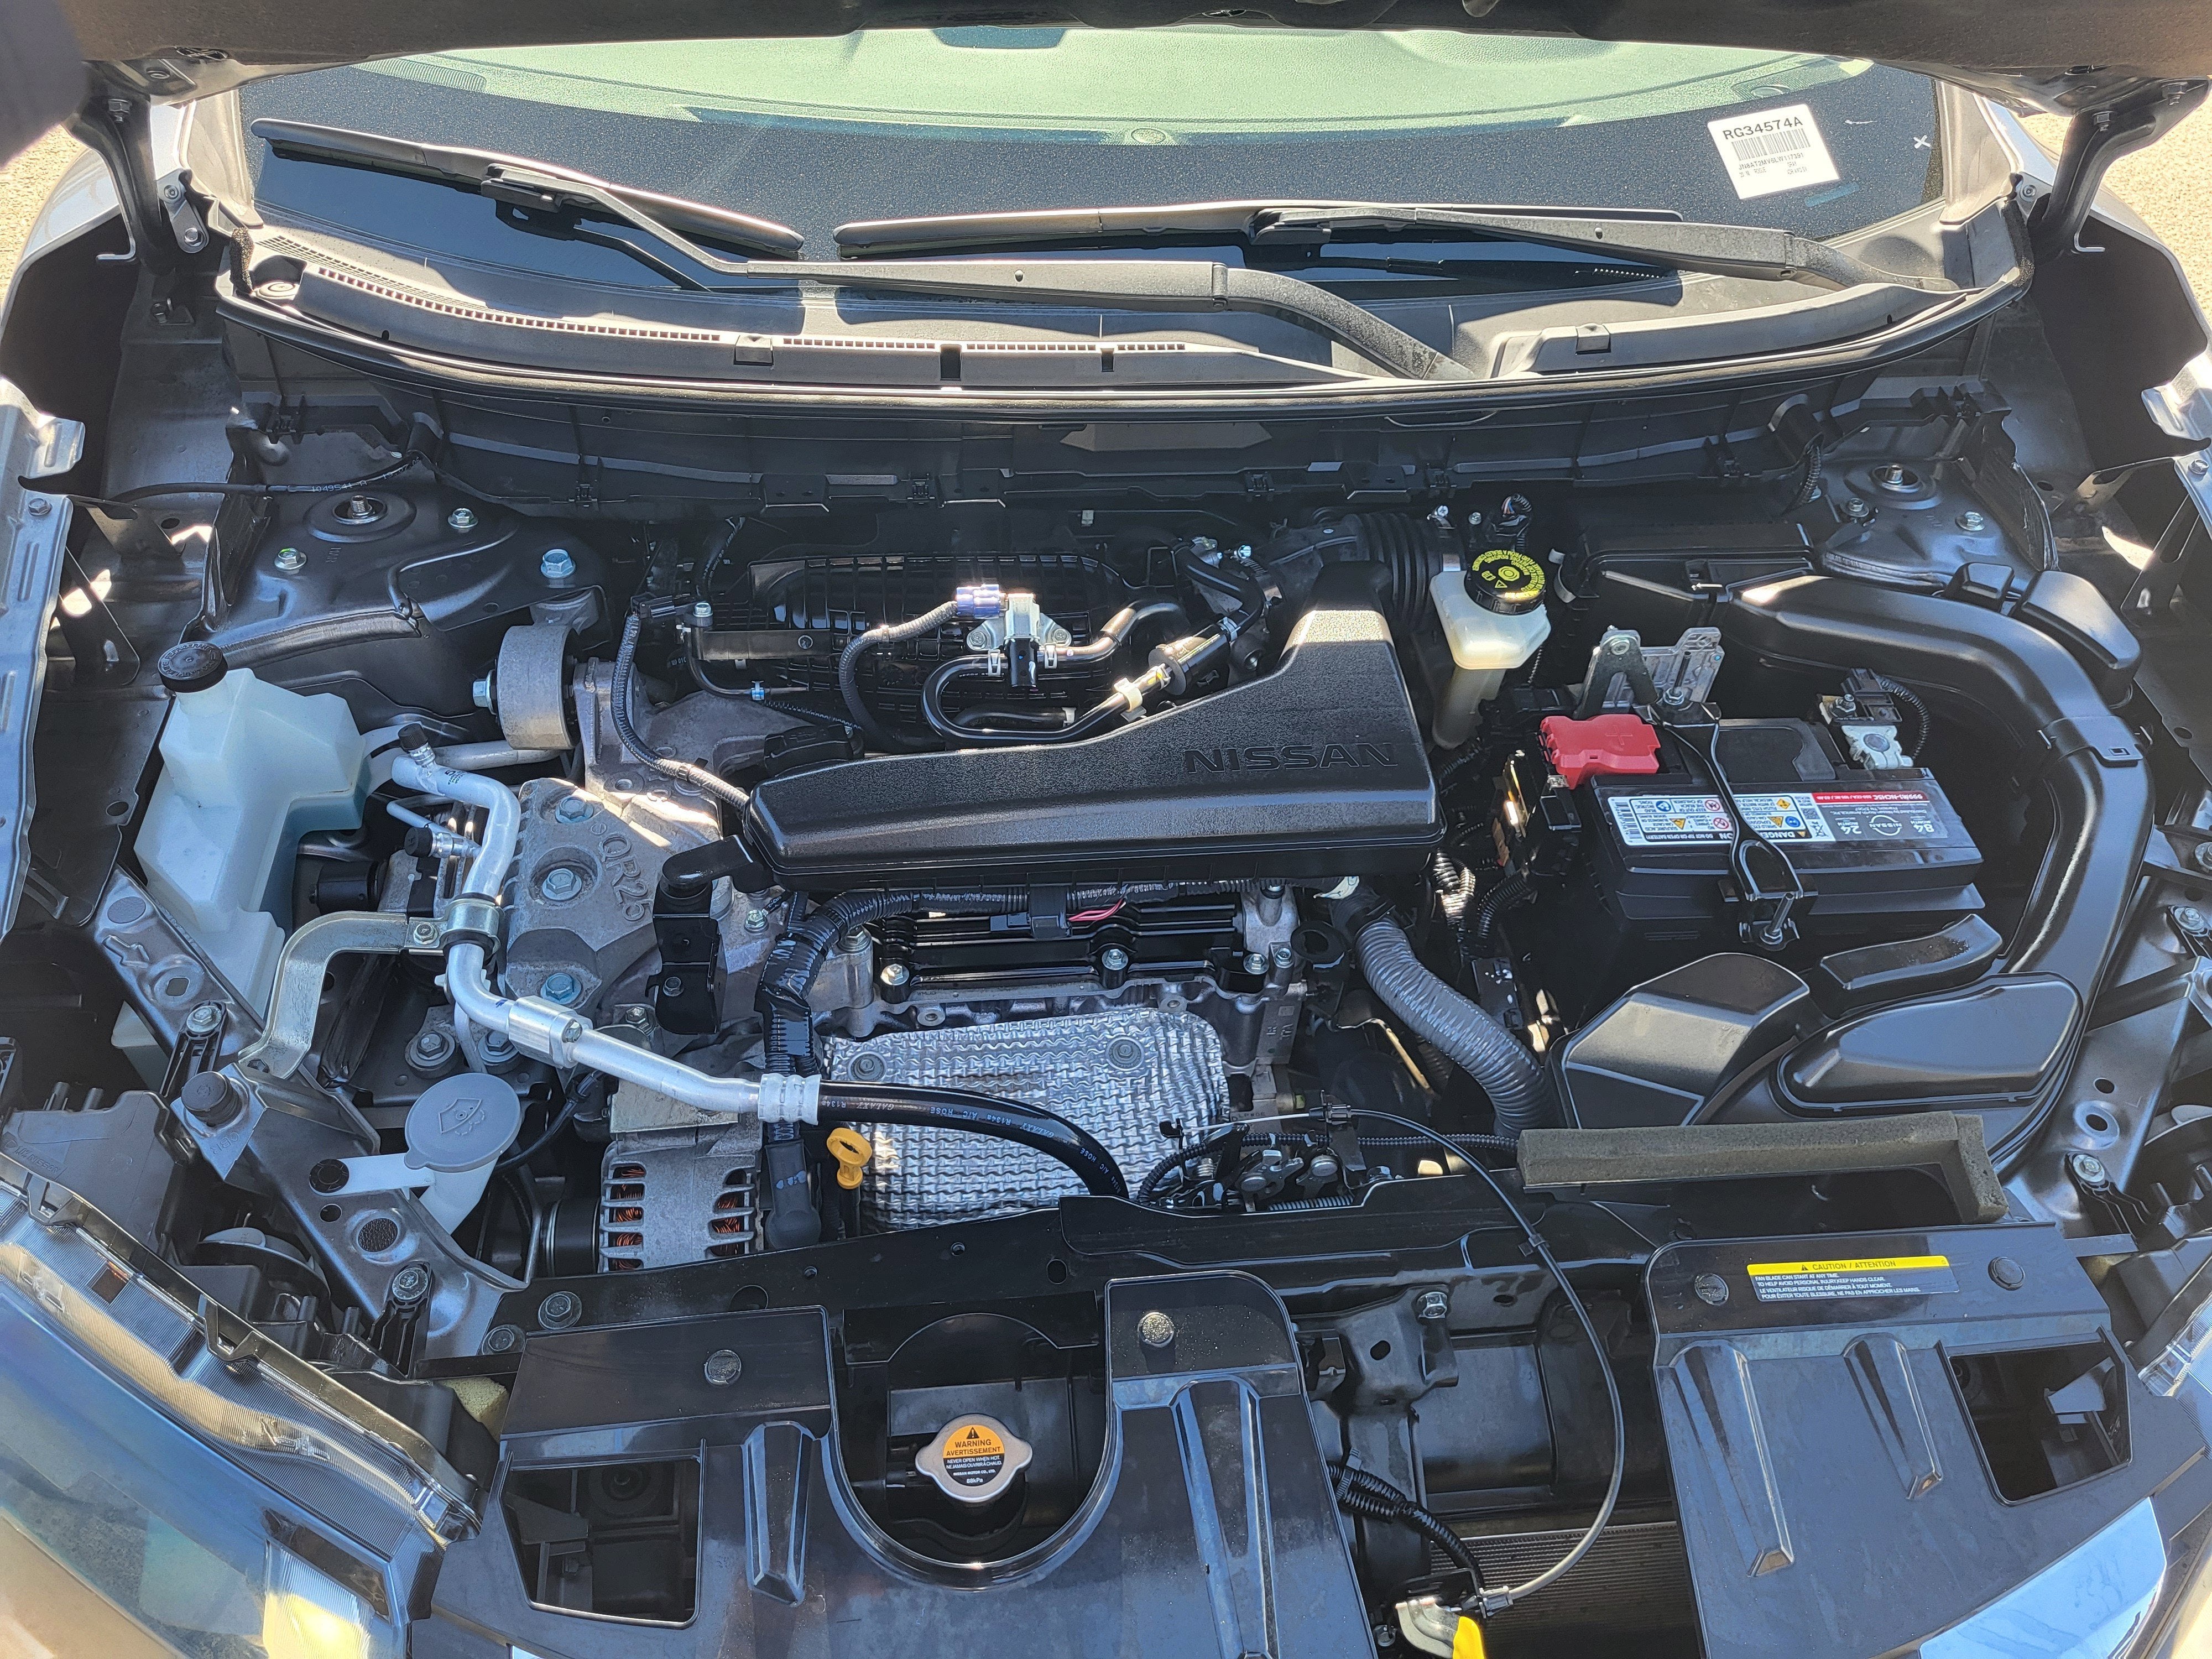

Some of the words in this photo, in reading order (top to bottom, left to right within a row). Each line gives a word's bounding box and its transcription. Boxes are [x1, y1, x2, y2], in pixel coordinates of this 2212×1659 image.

[1723, 116, 1803, 140] RG34574A
[1184, 742, 1399, 774] NISSAN
[1840, 826, 1862, 834] 24
[1913, 823, 1935, 833] 84
[598, 831, 654, 922] QR25
[821, 1100, 847, 1108] R134a
[856, 1101, 895, 1110] GALAXY
[930, 1106, 954, 1115] HOSE
[962, 1110, 978, 1121] A/C
[986, 1114, 1013, 1126] R134a
[1019, 1121, 1055, 1139] GALAXY
[1079, 1147, 1097, 1163] HOSE
[1099, 1163, 1109, 1175] A/C
[1855, 1260, 1896, 1269] ATTENTION
[954, 1439, 992, 1448] WARNING
[946, 1446, 1001, 1456] AVERTISSEMENT
